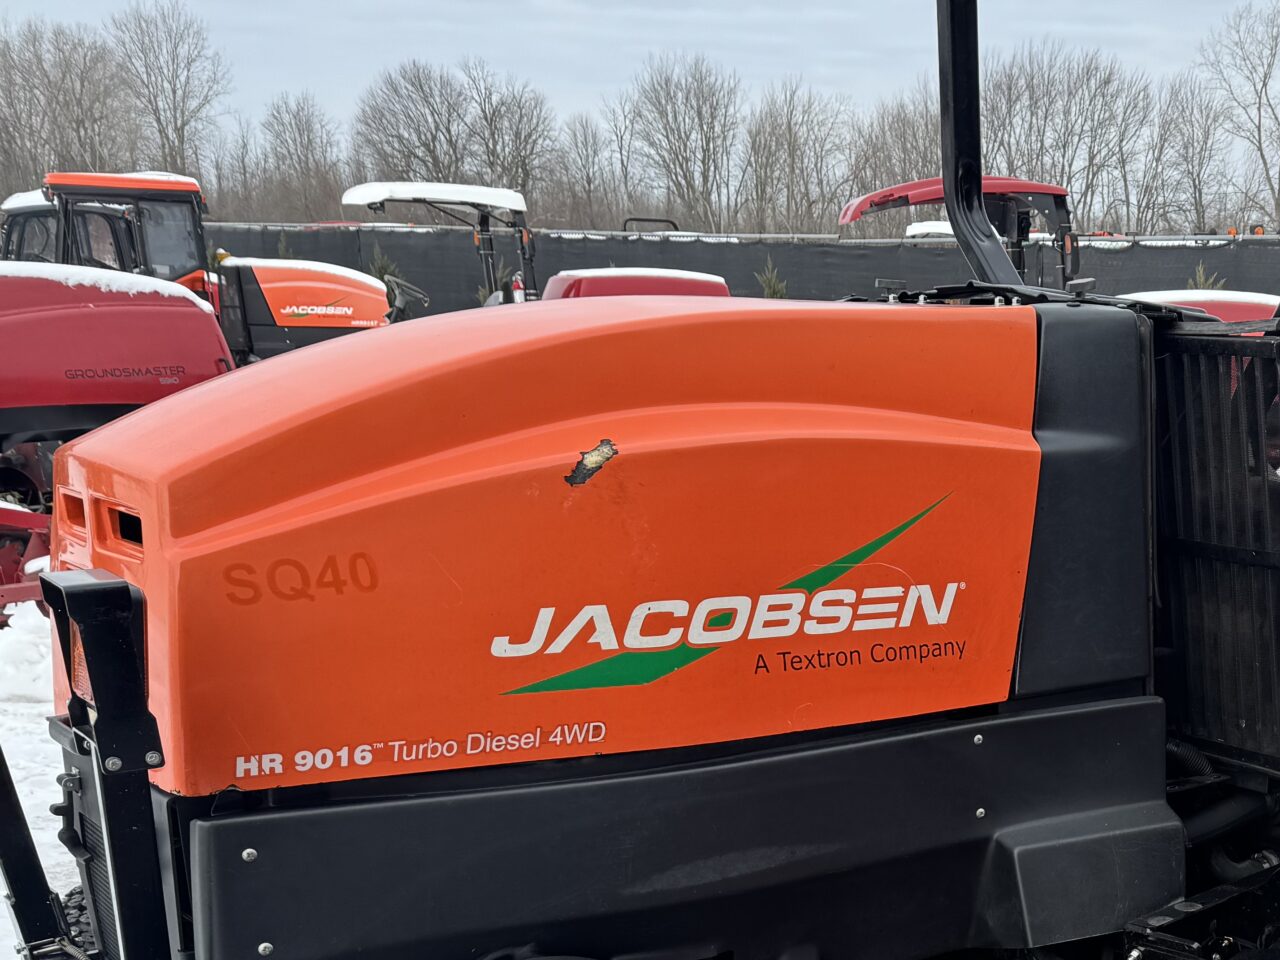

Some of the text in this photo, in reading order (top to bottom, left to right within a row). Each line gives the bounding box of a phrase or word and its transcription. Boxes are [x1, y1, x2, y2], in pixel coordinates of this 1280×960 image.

[280, 305, 354, 315] JACOBSEN
[64, 365, 186, 379] GROUNDSMASTER
[222, 552, 380, 606] SQ40
[754, 639, 967, 675] A Textron Company
[235, 752, 284, 778] HR
[388, 738, 457, 763] Turbo
[466, 727, 541, 755] Diesel
[548, 721, 606, 745] 4WD
